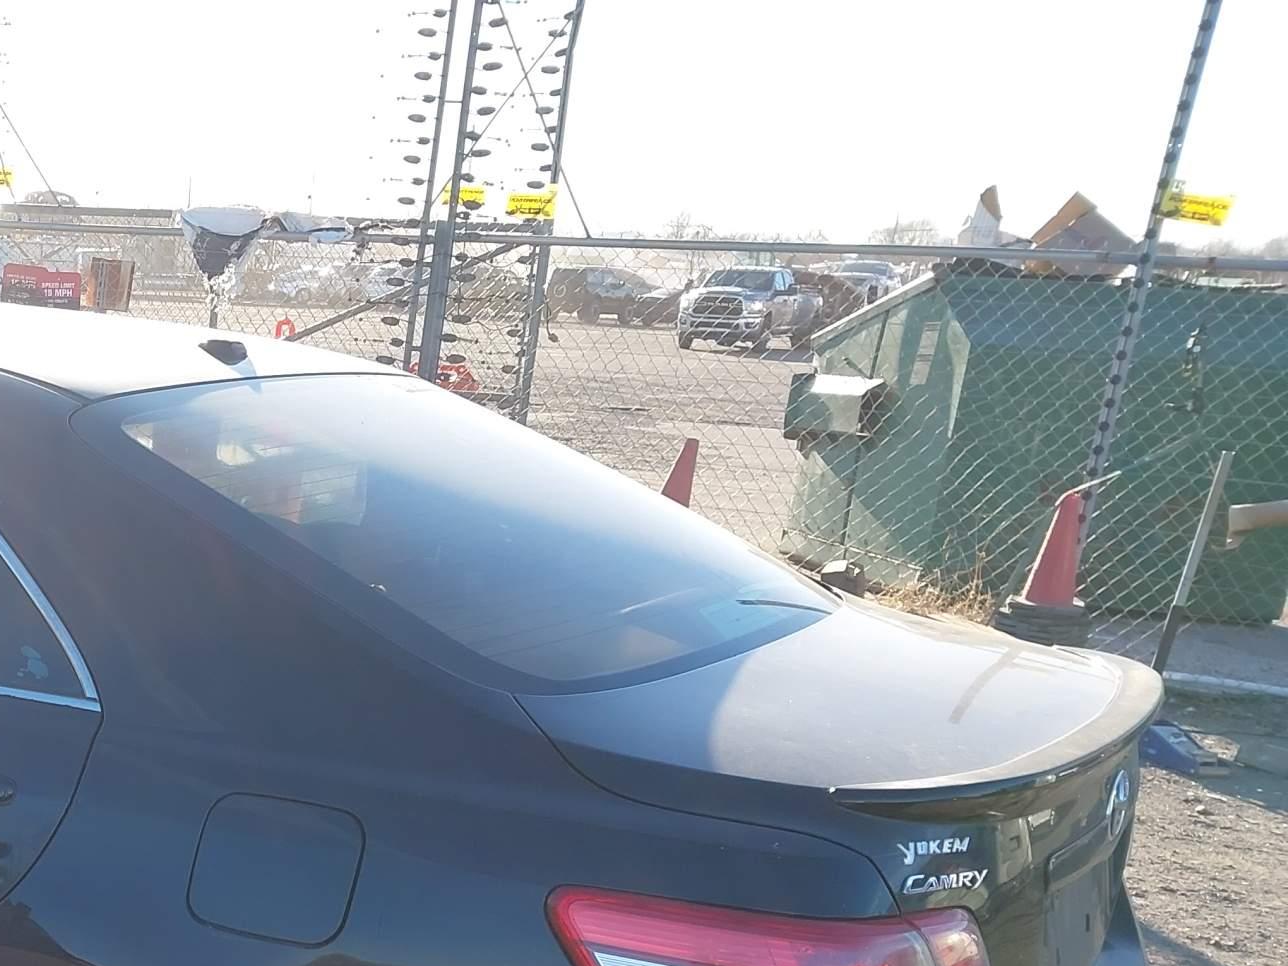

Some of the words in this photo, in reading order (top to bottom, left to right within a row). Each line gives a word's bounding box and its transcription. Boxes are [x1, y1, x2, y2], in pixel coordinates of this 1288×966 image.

[54, 289, 73, 297] MPH
[896, 836, 970, 866] YOKEM
[903, 868, 989, 896] CAMRY
